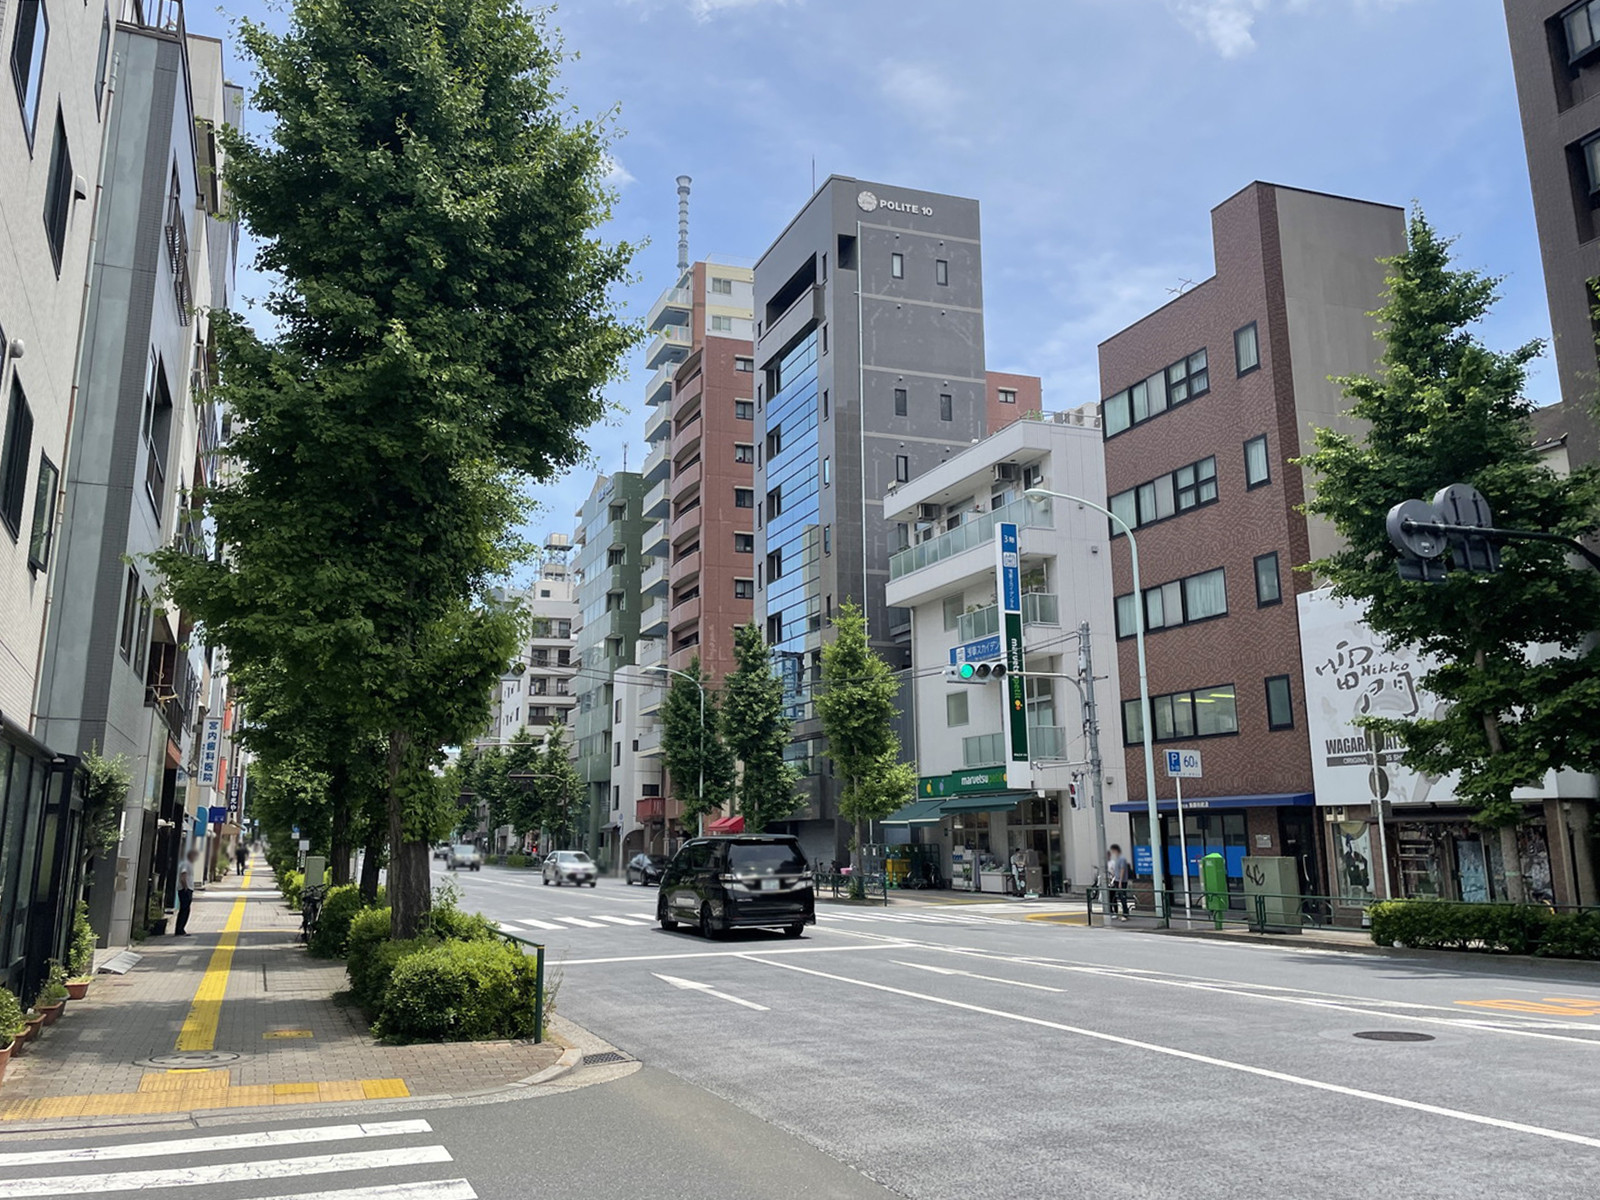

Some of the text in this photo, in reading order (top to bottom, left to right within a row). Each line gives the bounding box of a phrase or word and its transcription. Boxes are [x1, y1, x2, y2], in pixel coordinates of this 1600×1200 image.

[880, 199, 933, 216] POLITE 10
[1361, 661, 1409, 677] Nikko
[203, 721, 219, 783] 宮内歯科医院
[1171, 753, 1178, 764] P
